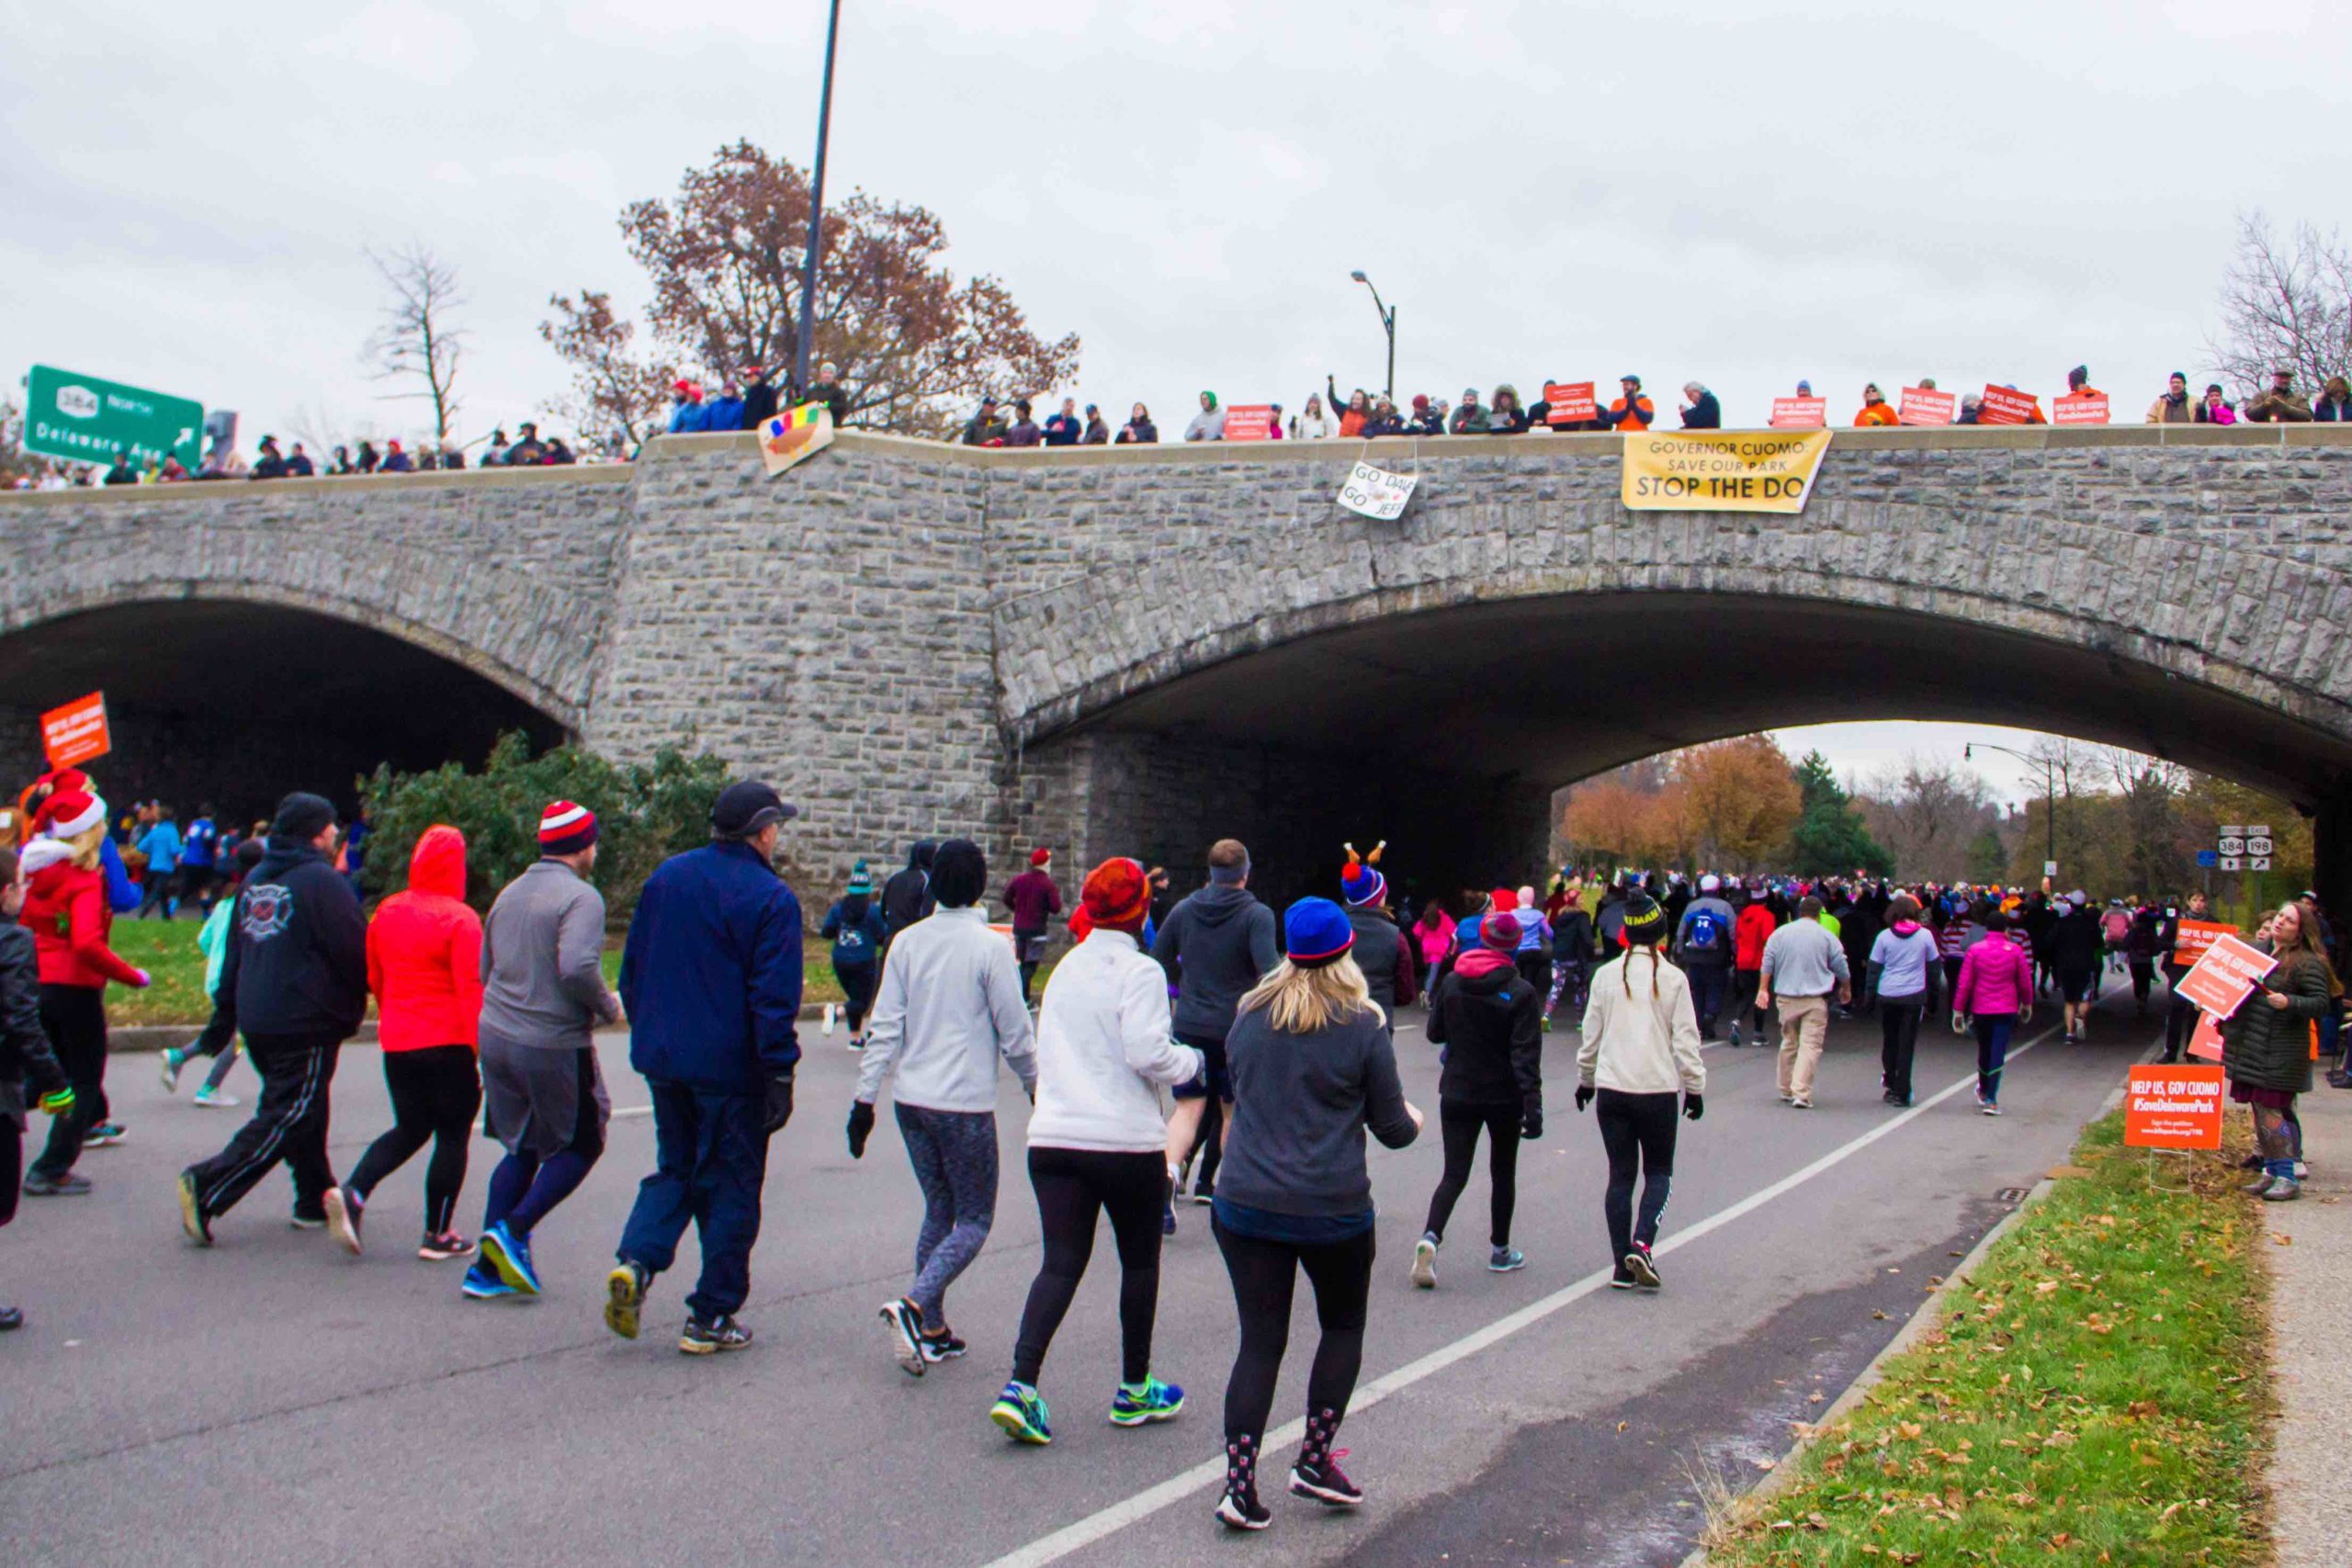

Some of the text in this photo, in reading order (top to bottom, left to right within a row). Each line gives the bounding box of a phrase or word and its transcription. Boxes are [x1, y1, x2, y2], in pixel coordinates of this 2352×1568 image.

[36, 422, 164, 463] Delaware Ave
[1649, 441, 1737, 456] GOVERNOR
[1668, 458, 1788, 473] SAVE OUR PARK
[1355, 466, 1381, 482] GO
[1636, 476, 1700, 497] STOP
[1709, 477, 1754, 498] THE
[1345, 487, 1403, 514] GO JEFF
[2221, 841, 2243, 852] 384
[2250, 841, 2269, 852] 198
[2131, 1080, 2220, 1097] HELP US, GOV CUOMO
[2133, 1097, 2214, 1113] #SaveDelawarePark
